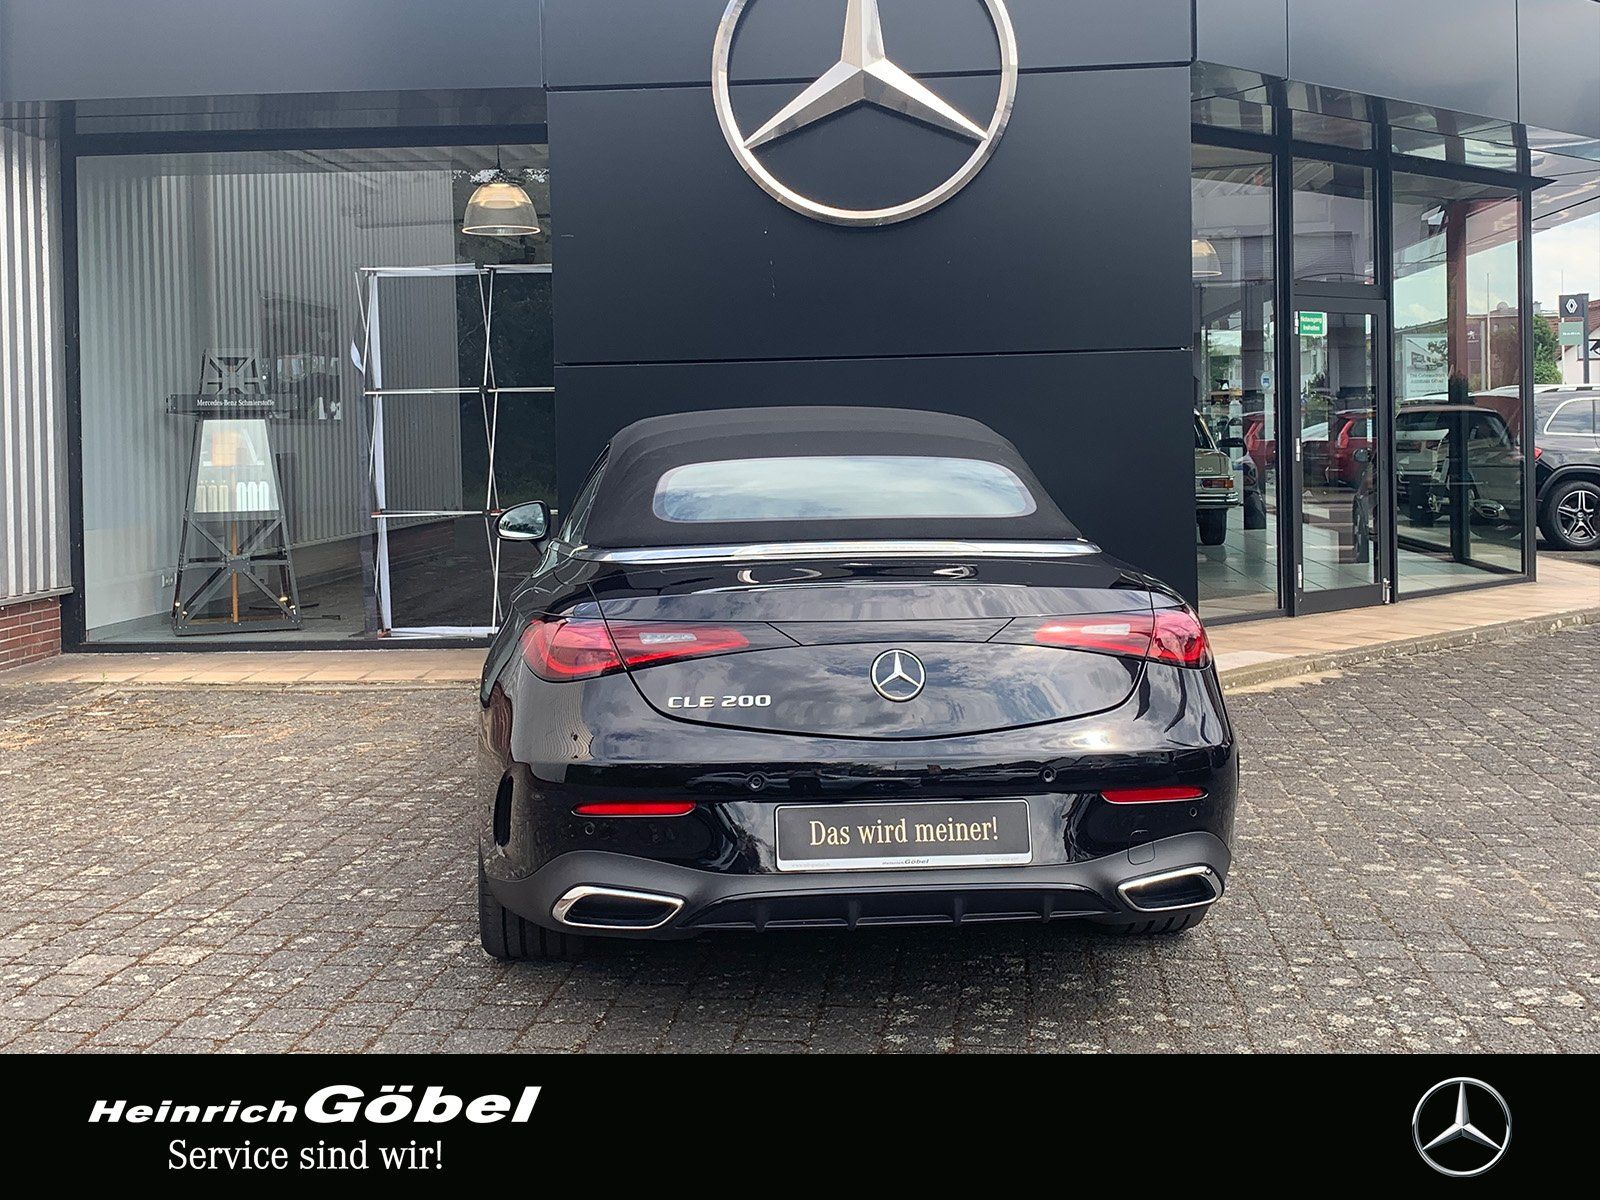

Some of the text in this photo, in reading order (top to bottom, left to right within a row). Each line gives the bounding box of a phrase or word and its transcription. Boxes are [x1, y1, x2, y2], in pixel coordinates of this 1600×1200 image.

[667, 694, 772, 709] CLE 200
[809, 816, 999, 847] Das wird meiner!
